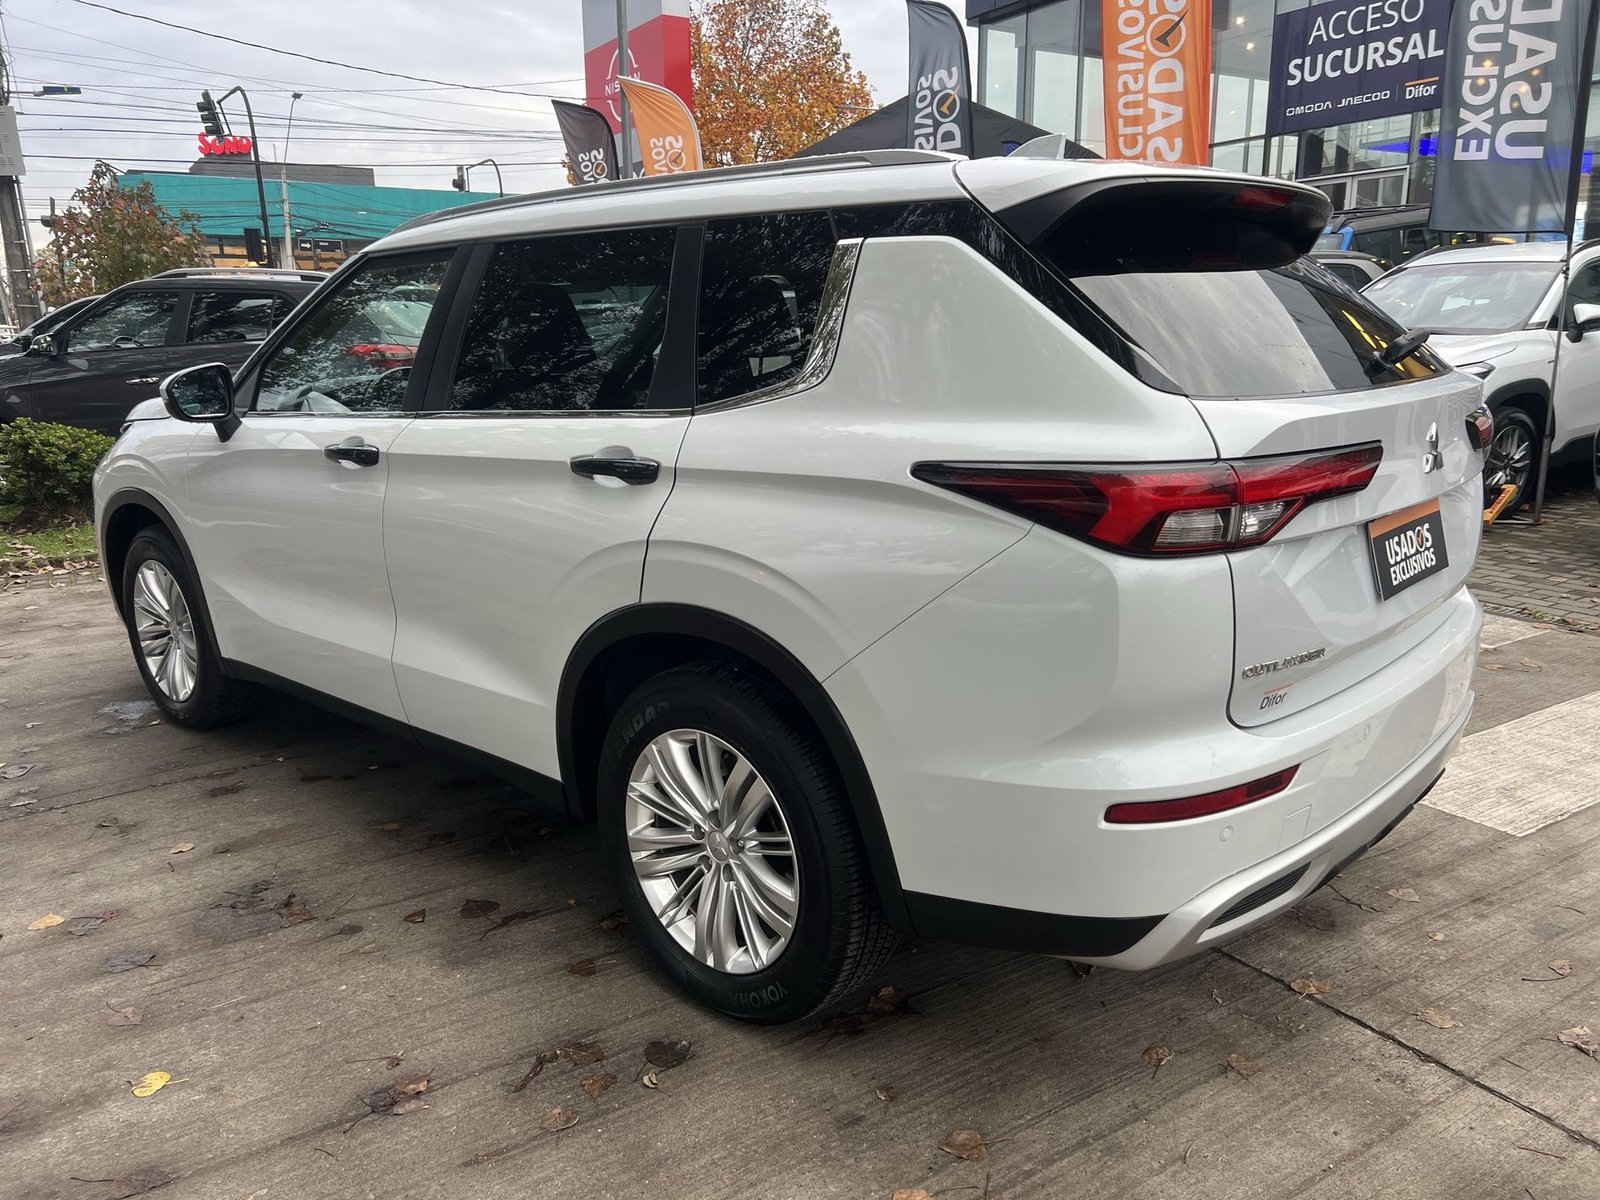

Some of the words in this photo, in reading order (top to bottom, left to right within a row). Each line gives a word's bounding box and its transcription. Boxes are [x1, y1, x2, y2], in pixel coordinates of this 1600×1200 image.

[1308, 0, 1424, 45] ACCESO
[1286, 29, 1444, 86] SUCURSAL
[604, 71, 640, 97] NISN
[1405, 84, 1437, 99] Difor
[1286, 101, 1333, 117] OMODA
[1385, 522, 1433, 565] USADOS
[1390, 548, 1436, 586] EXCLUSIVOS
[1242, 647, 1326, 679] OUTLANDER
[1260, 692, 1287, 710] Difor
